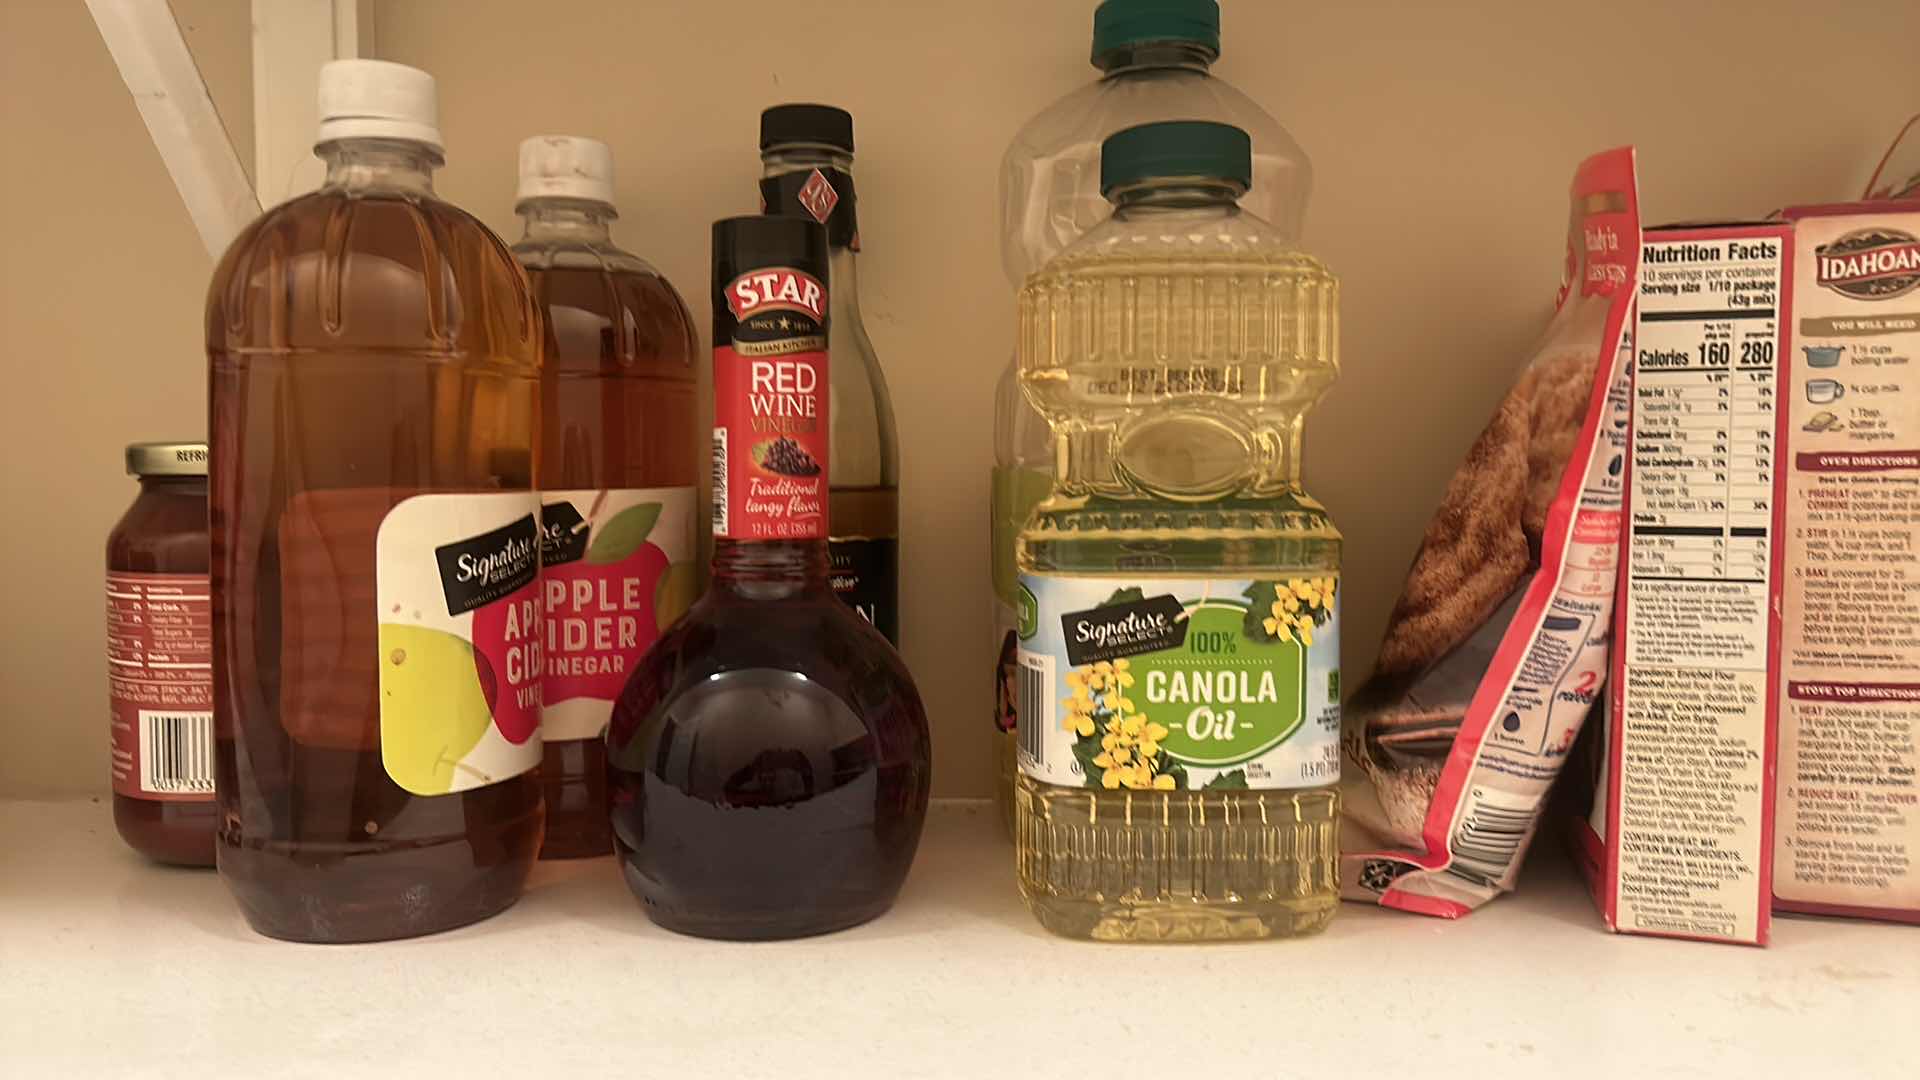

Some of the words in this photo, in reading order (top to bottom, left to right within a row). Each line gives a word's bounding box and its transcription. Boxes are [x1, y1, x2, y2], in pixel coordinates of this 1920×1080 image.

[1642, 245, 1720, 264] Nutrition
[1728, 242, 1777, 261] Facts
[1821, 247, 1920, 280] IDAHOAN
[1643, 271, 1654, 282] 10
[1657, 270, 1702, 283] servings
[1706, 270, 1723, 281] per
[1726, 266, 1776, 279] container
[736, 273, 821, 315] STAR
[1641, 283, 1678, 296] Serving
[1681, 283, 1700, 293] size
[1709, 281, 1731, 292] 1/10
[1734, 279, 1776, 294] package
[1728, 296, 1750, 309] (43g
[1753, 293, 1776, 306] mix)
[1832, 321, 1854, 330] YOU
[1857, 320, 1883, 330] WILL
[1885, 319, 1917, 330] NEED
[746, 343, 781, 353] ITALIAN
[1639, 349, 1689, 367] Calories
[1698, 343, 1730, 365] 160
[1741, 341, 1773, 364] 280
[1870, 346, 1892, 356] cups
[1850, 355, 1880, 368] boiling
[1884, 356, 1909, 365] water
[752, 361, 817, 393] RED
[1881, 383, 1900, 393] milk
[749, 393, 817, 417] WINE
[1849, 419, 1876, 430] butter
[1849, 430, 1896, 443] margarine
[176, 449, 208, 462] REFRI
[1819, 455, 1850, 467] OVEN
[1851, 455, 1919, 467] DIRECTIONS
[750, 477, 819, 497] Traditional
[745, 497, 784, 518] tangy
[546, 578, 641, 613] PPLE
[547, 618, 638, 653] IDER
[1076, 611, 1164, 648] Signature
[1189, 631, 1237, 655] 100%
[548, 656, 625, 677] INEGAR
[1146, 670, 1277, 704] CANOLA
[1624, 831, 1666, 844] CONTAINS
[1623, 843, 1659, 855] CONTAIN
[1623, 873, 1658, 884] Contains
[1660, 876, 1720, 890] Bioengineered
[1623, 884, 1642, 895] Food
